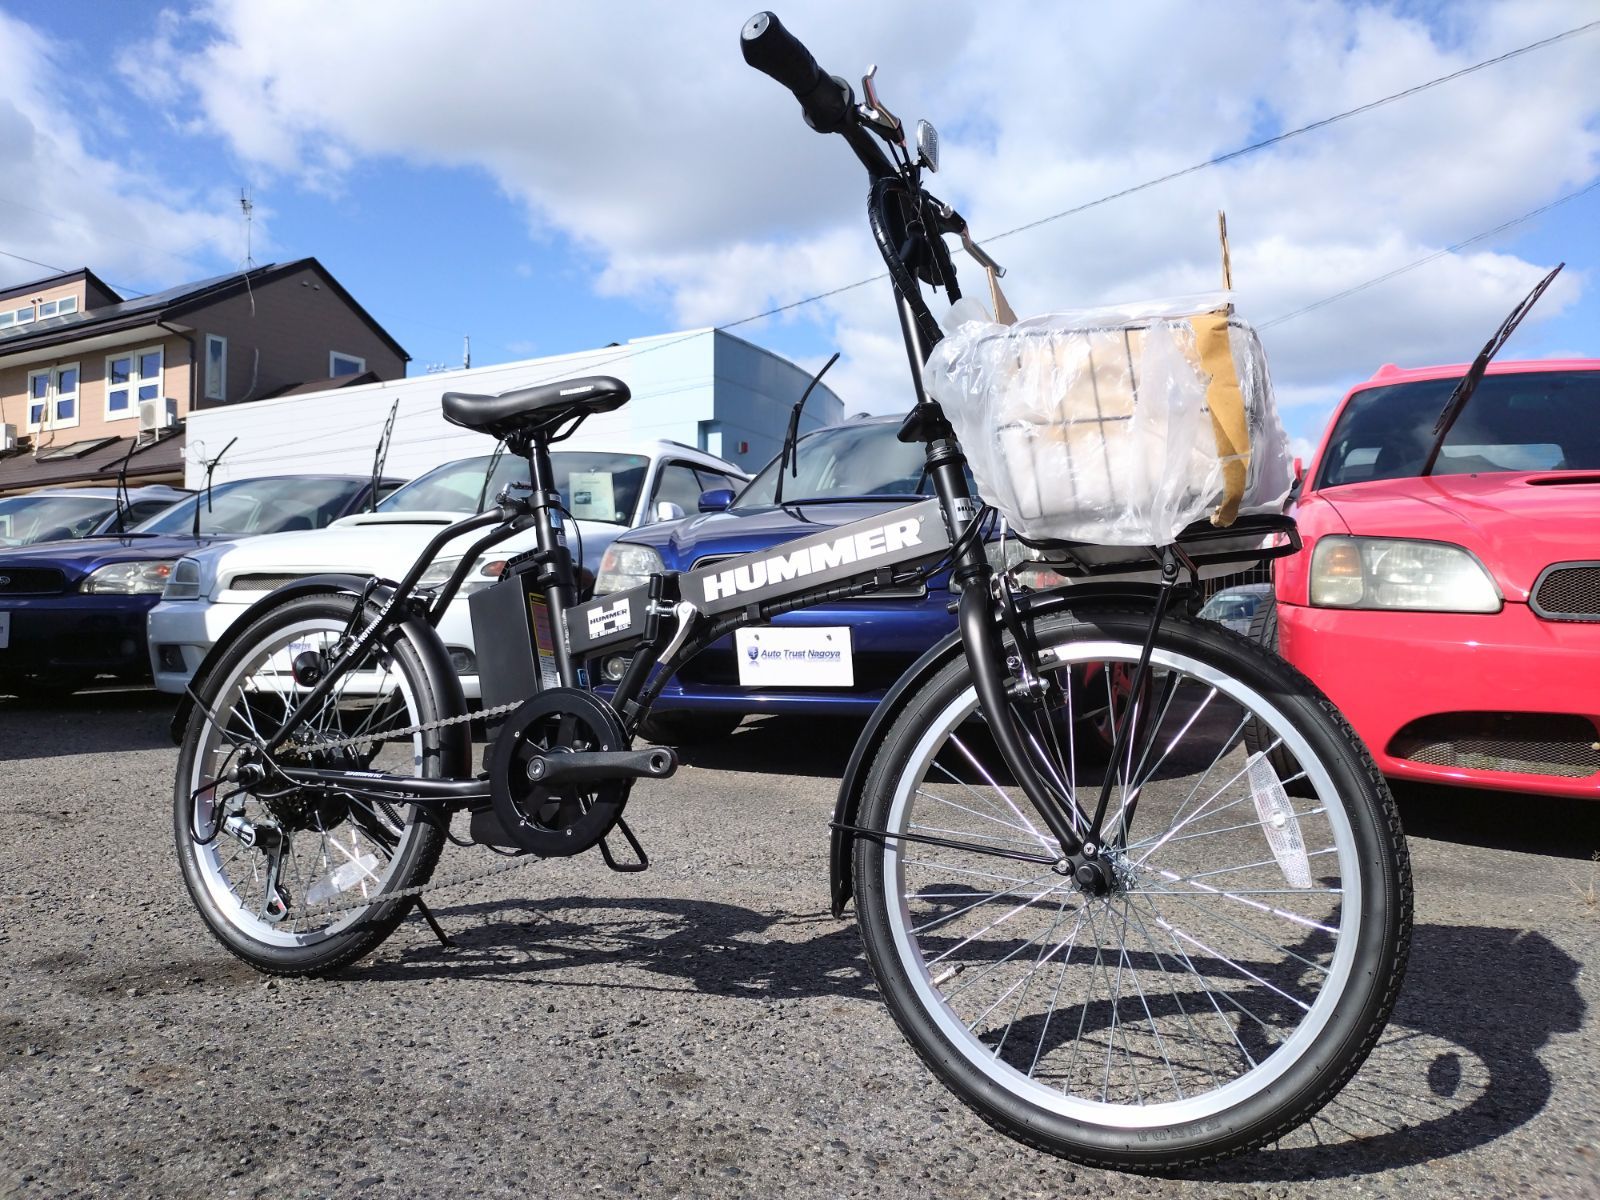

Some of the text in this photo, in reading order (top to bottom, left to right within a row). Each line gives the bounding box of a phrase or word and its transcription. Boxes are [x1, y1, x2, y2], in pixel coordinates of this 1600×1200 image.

[590, 609, 627, 624] HUMMER
[346, 641, 360, 656] LIKE
[358, 614, 382, 642] NOTHING
[761, 649, 840, 659] Auto Trust Nagoya
